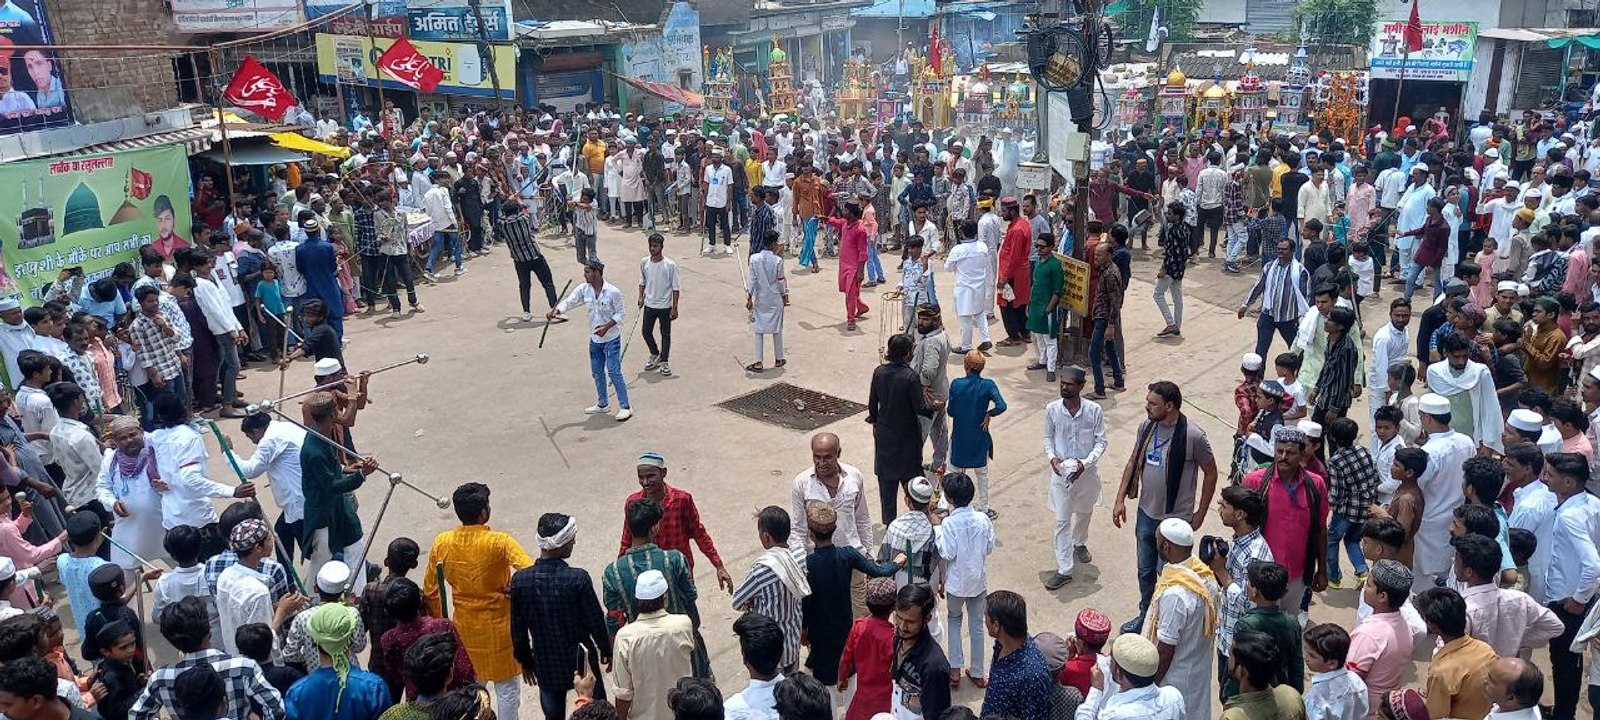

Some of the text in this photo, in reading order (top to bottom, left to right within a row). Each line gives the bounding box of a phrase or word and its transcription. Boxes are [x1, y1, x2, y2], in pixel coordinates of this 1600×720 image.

[414, 12, 459, 32] अमित
[56, 252, 65, 267] के
[90, 245, 102, 259] पर
